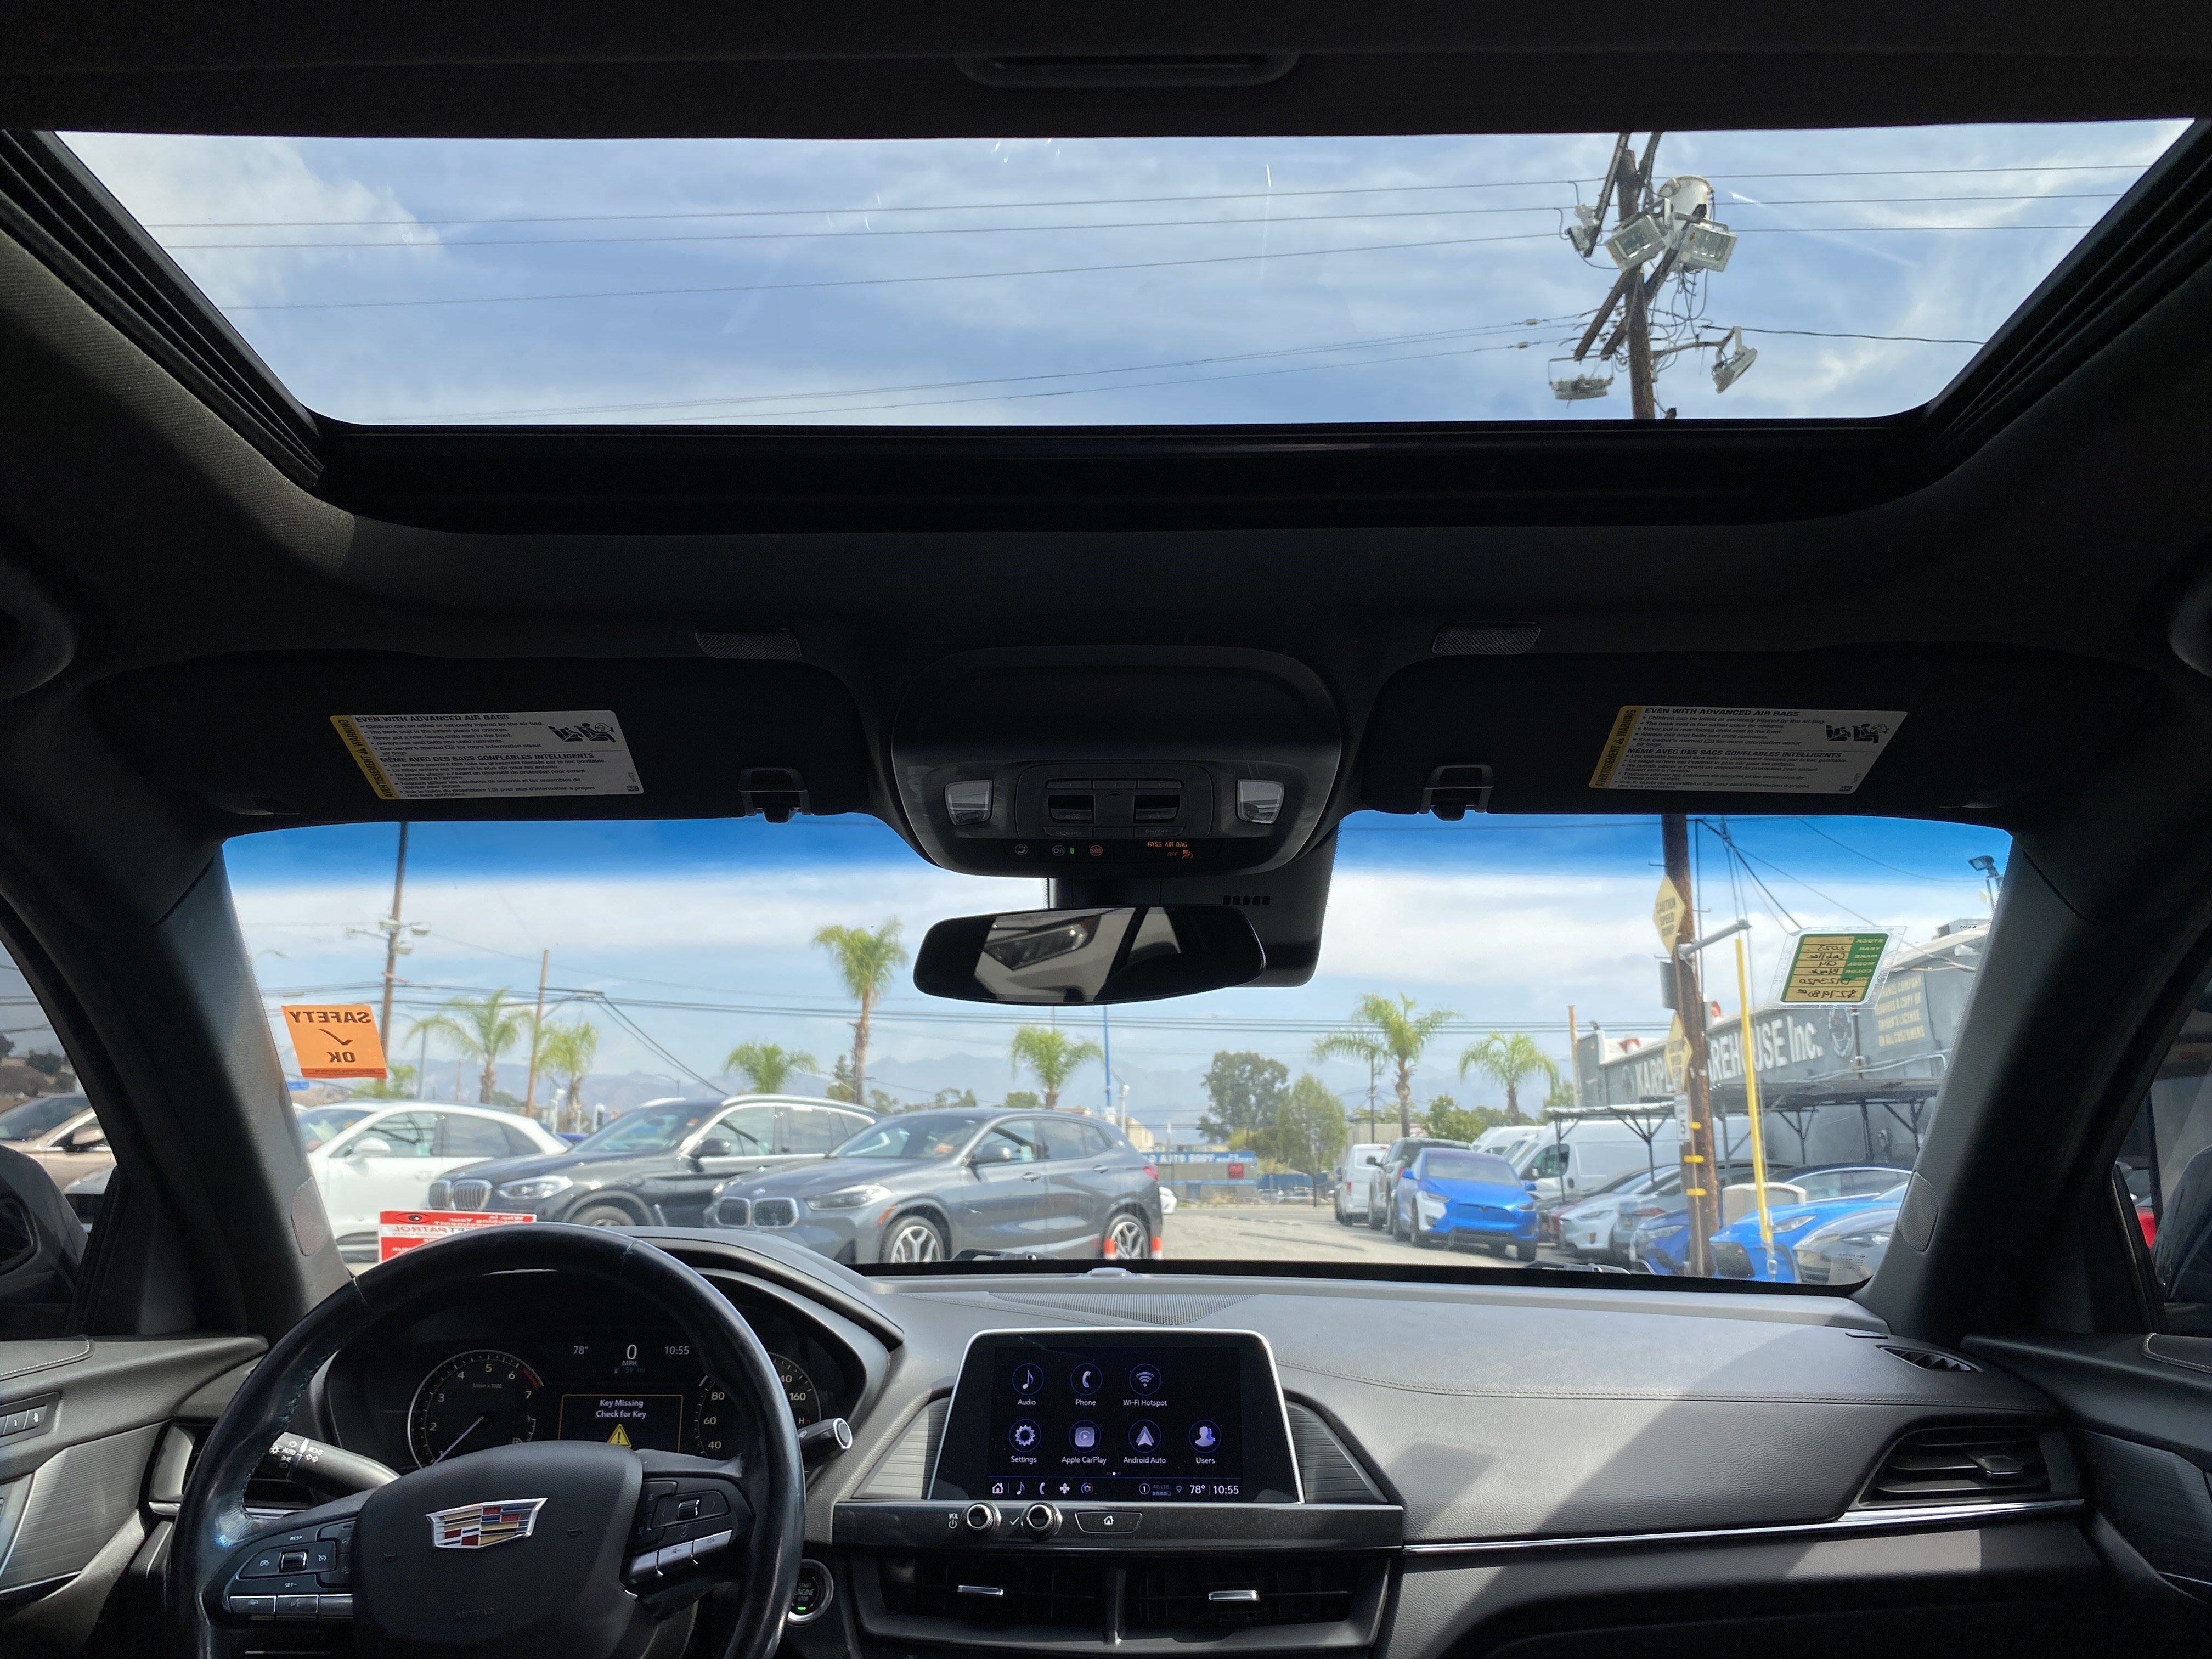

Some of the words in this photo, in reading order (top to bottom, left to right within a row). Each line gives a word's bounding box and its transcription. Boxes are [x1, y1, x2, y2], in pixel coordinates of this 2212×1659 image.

[1617, 710, 1637, 736] WARNING
[338, 720, 362, 746] WARNING
[1595, 745, 1621, 787] AVERTISSEMENT
[360, 754, 394, 798] AVERTISSEMENT
[1656, 897, 1676, 913] CAUTION
[1787, 1014, 1824, 1063] Inc.
[1680, 1120, 1686, 1134] 5
[1159, 1154, 1187, 1163] AUTO
[573, 1345, 588, 1355] 78°
[626, 1344, 637, 1359] 0
[664, 1346, 690, 1355] 10:55
[485, 1363, 493, 1373] 5
[457, 1371, 465, 1380] 4
[509, 1370, 516, 1380] 6
[438, 1393, 445, 1402] 3
[525, 1390, 532, 1400] 7
[711, 1392, 725, 1401] 80
[789, 1392, 806, 1401] 160
[600, 1400, 613, 1408] Key
[614, 1400, 644, 1408] Missing
[596, 1410, 618, 1418] Check
[633, 1410, 647, 1419] Key
[703, 1417, 717, 1425] 60
[430, 1423, 437, 1431] 2
[708, 1441, 722, 1449] 40
[282, 1447, 296, 1455] AUTO
[1010, 1455, 1037, 1464] Settings
[1061, 1456, 1080, 1464] Apple
[1081, 1456, 1107, 1465] CarPlay
[1189, 1484, 1206, 1495] 78°
[1212, 1485, 1239, 1495] 10:55
